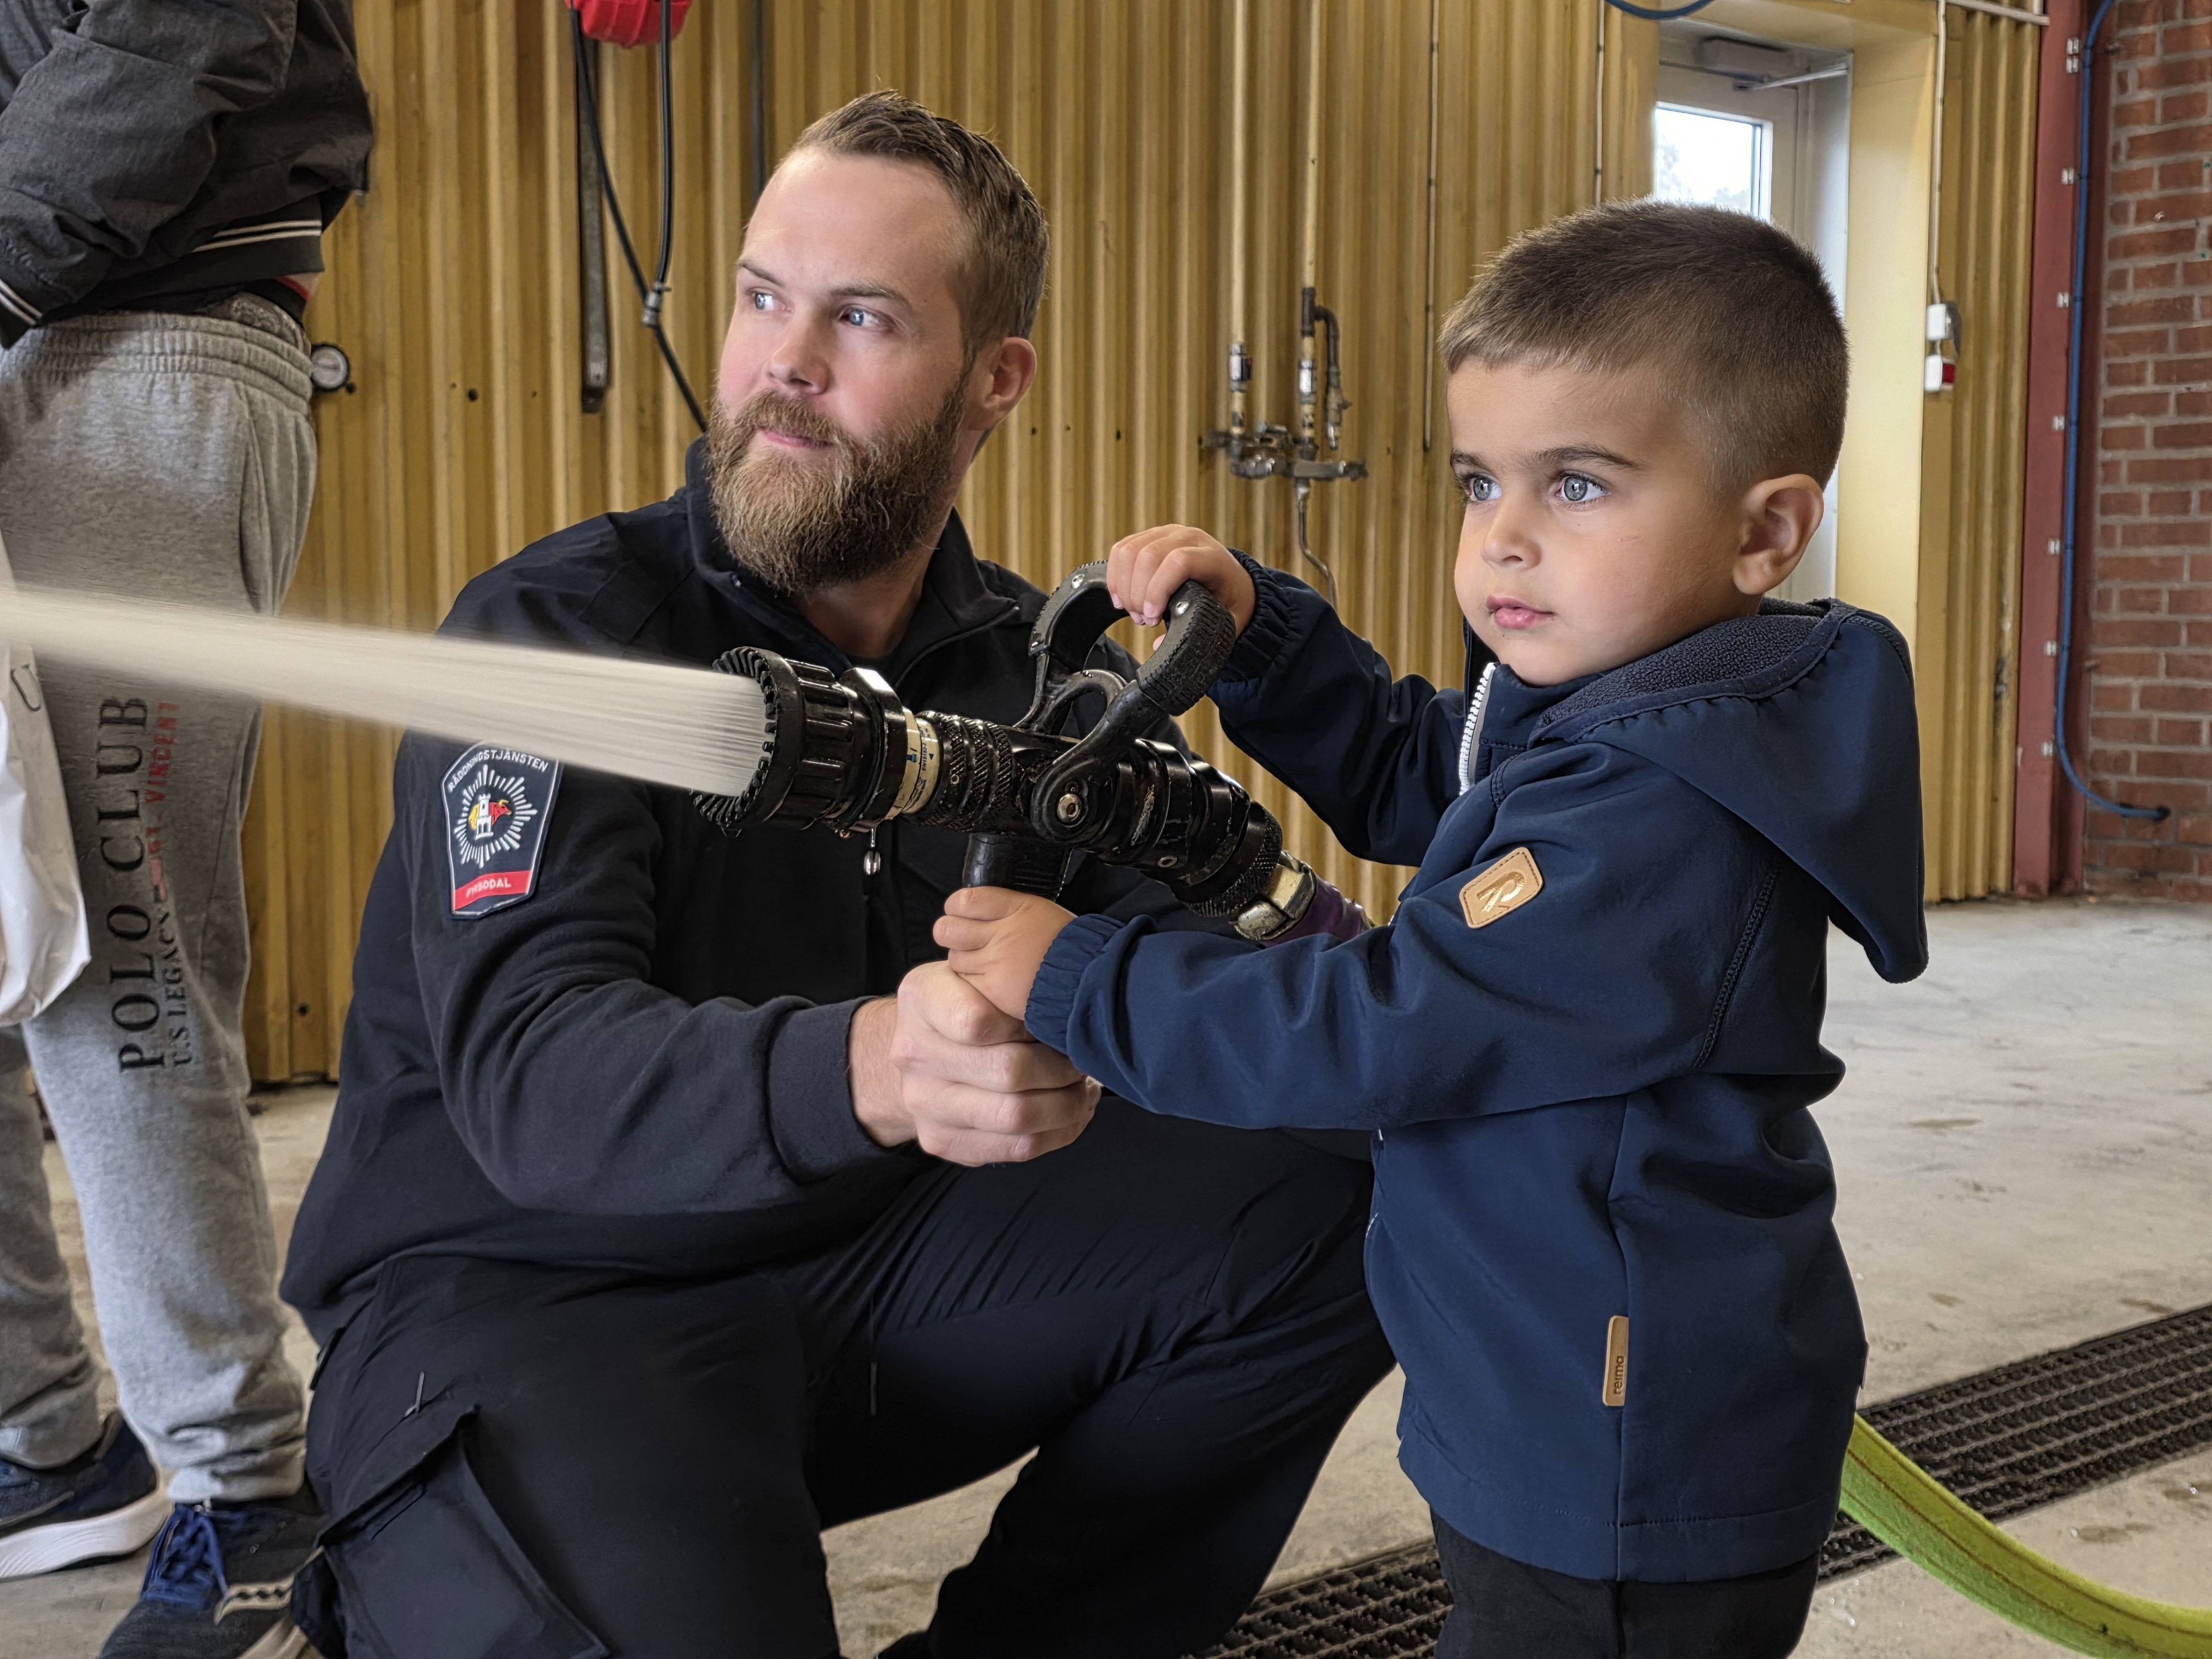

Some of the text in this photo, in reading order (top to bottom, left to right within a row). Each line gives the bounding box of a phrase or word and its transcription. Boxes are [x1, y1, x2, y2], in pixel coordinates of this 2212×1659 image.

[97, 698, 165, 1073] POLO CLUB
[1614, 1356, 1624, 1395] reima
